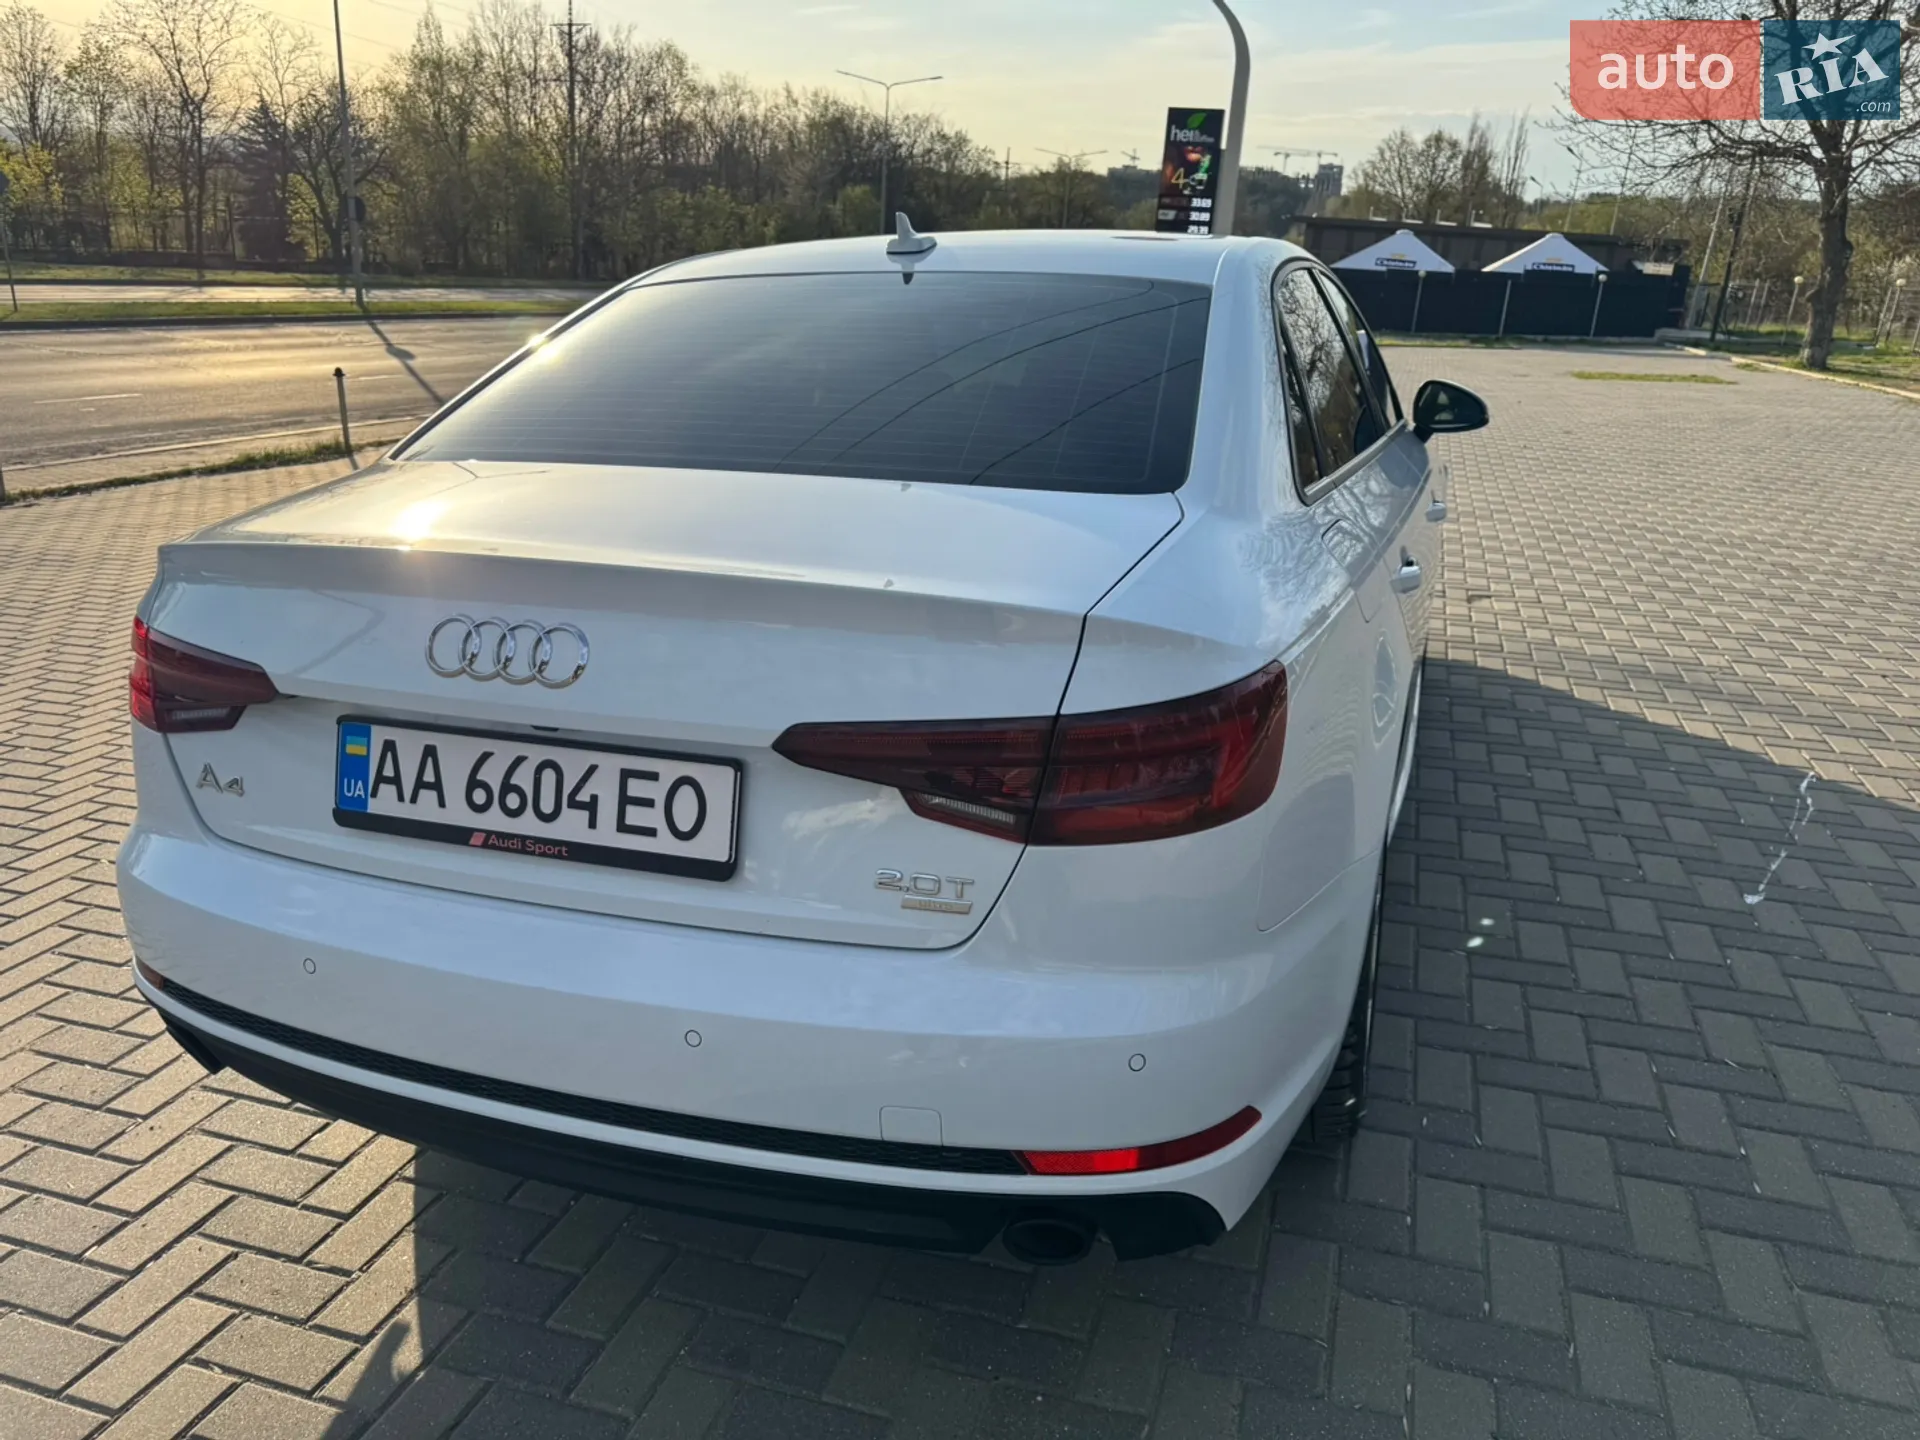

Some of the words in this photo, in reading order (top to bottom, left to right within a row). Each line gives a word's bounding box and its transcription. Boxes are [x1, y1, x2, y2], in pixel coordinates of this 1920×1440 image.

[195, 762, 245, 797] A4
[343, 777, 366, 799] UA
[369, 738, 447, 809] AA
[464, 751, 599, 830] 6604
[616, 768, 708, 842] EO
[488, 834, 522, 850] Audi
[525, 839, 569, 857] Sport
